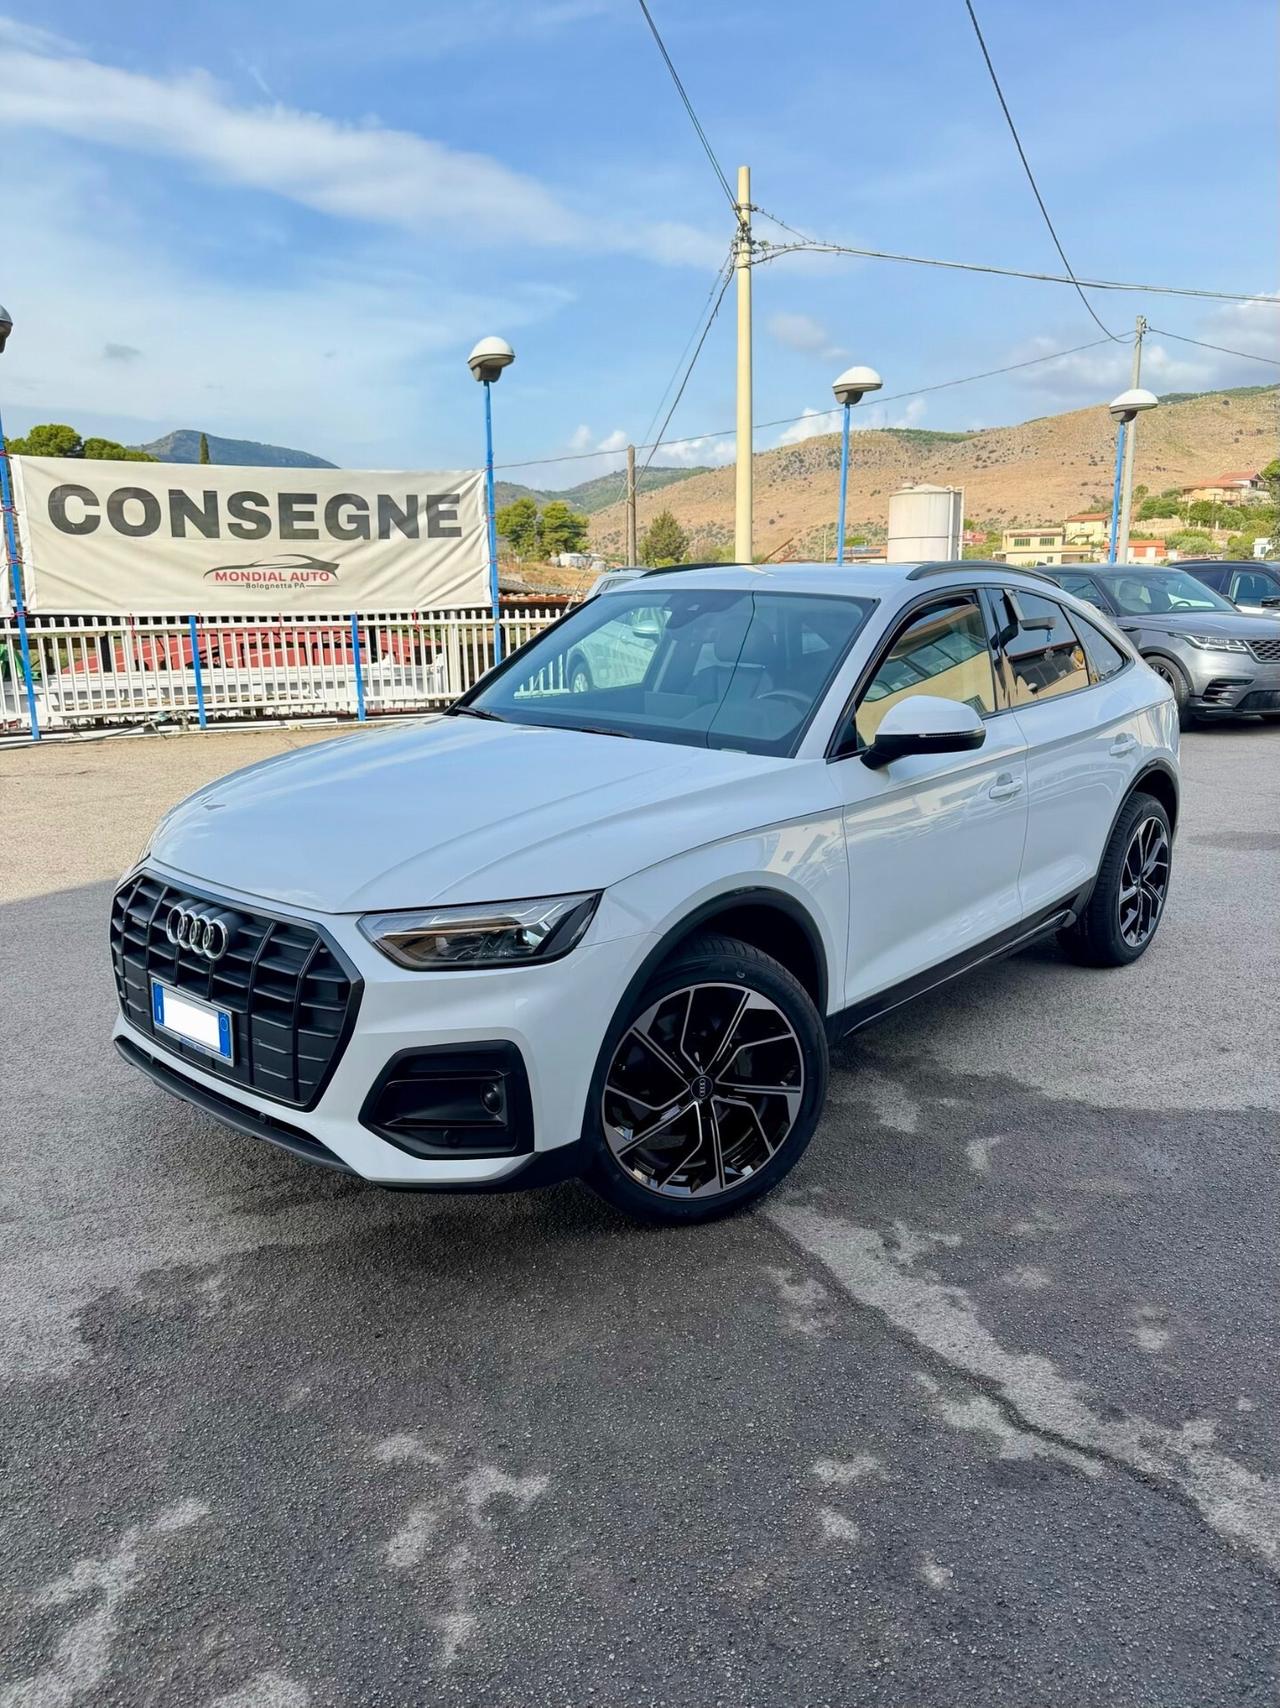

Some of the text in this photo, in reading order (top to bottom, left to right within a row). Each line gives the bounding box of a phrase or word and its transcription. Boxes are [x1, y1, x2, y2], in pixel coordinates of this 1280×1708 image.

[47, 483, 463, 541] CONSEGNE
[215, 571, 329, 581] MONDIAL AUTO
[245, 582, 293, 590] Bolognetta
